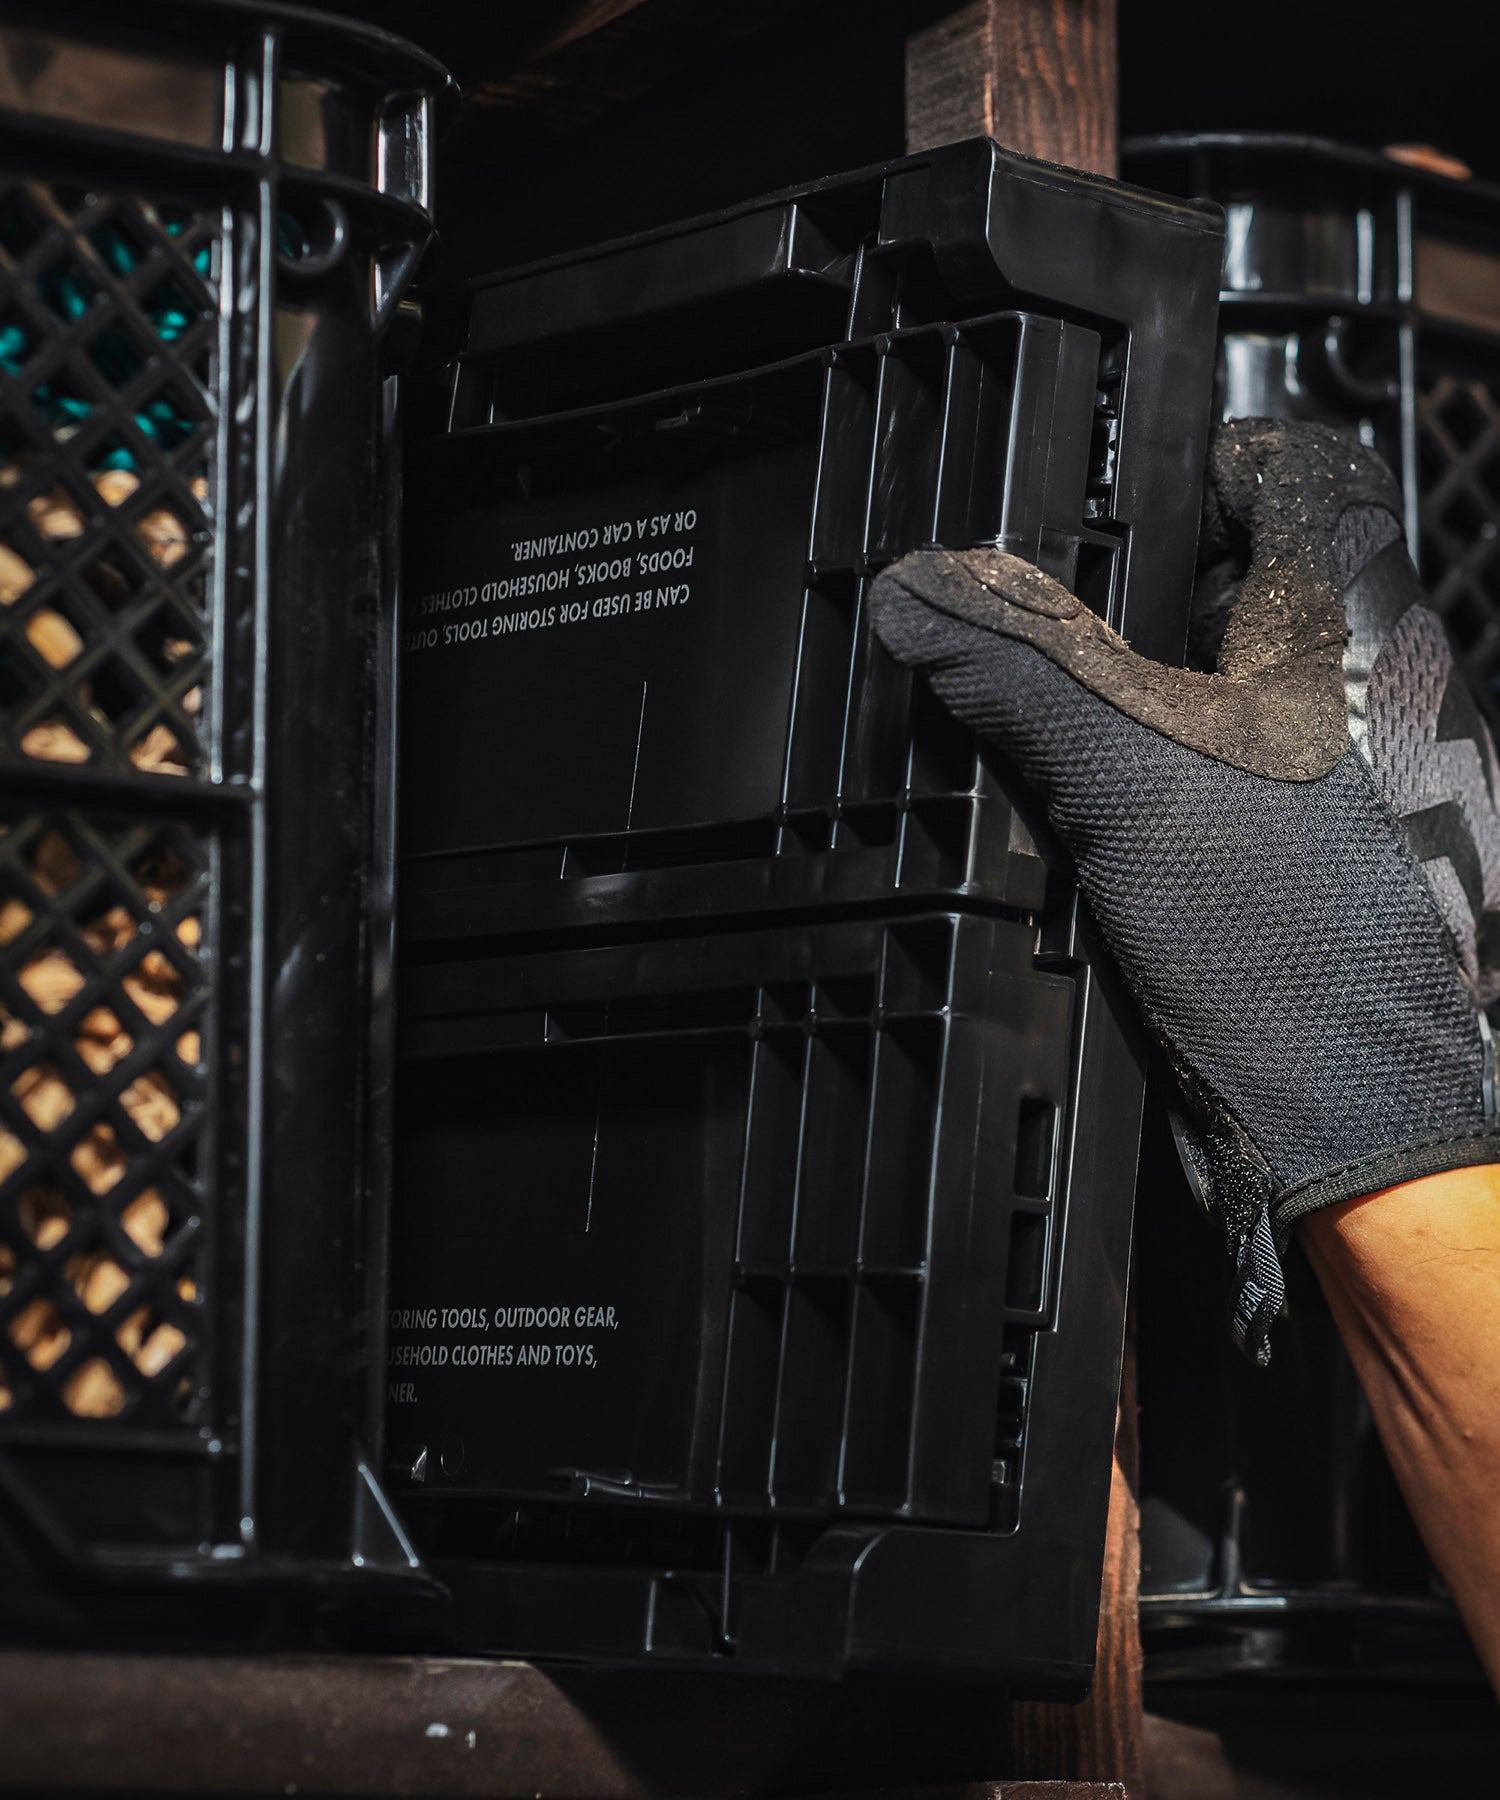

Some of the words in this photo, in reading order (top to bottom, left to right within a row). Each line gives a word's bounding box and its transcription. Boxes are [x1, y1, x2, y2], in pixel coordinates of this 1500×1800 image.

[603, 522, 632, 545] CAR
[636, 518, 648, 539] A
[650, 514, 671, 537] AS
[674, 510, 697, 532] OR
[511, 528, 599, 562] CONTAINER.
[574, 557, 631, 586] BOOKS,
[636, 546, 694, 575] FOODS,
[481, 568, 570, 605] HOUSEHOLD
[656, 584, 690, 608] CAN
[422, 586, 478, 615] CLOTHES
[560, 600, 589, 624] FOR
[592, 593, 631, 618] USED
[634, 589, 652, 612] BE
[442, 618, 488, 644] TOOLS,
[492, 606, 556, 636] STORING
[441, 1308, 490, 1331] TOOLS,
[494, 1307, 570, 1328] OUTDOOR
[574, 1306, 619, 1331] GEAR,
[452, 1345, 514, 1366] CLOTHES
[516, 1345, 551, 1366] AND
[555, 1344, 597, 1368] TOYS,
